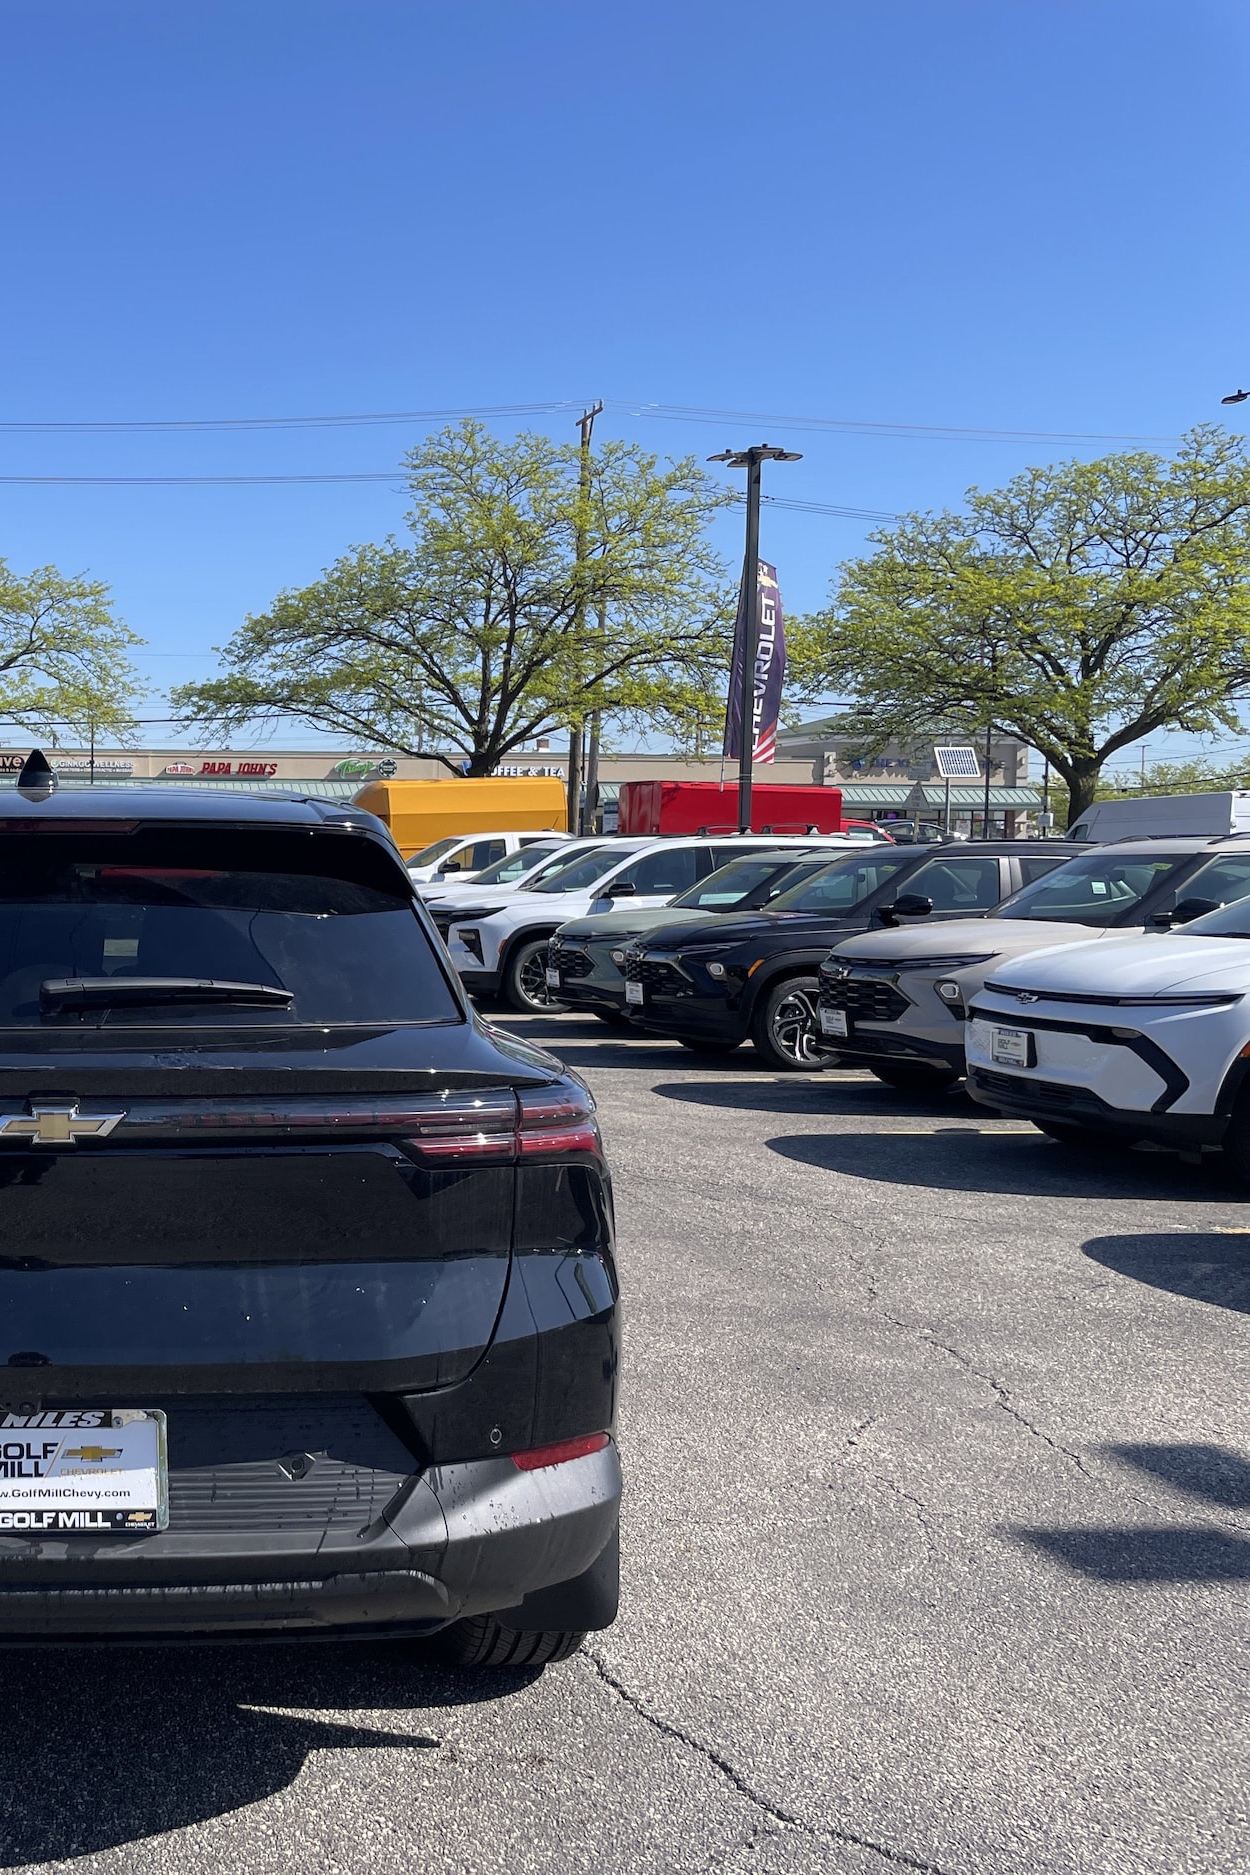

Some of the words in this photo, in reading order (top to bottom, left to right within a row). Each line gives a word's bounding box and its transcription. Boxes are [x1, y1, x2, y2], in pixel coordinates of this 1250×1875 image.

[201, 762, 231, 775] PAPA
[236, 763, 277, 775] JOHN'S
[491, 766, 523, 776] OFFEE
[528, 766, 538, 776] &
[544, 766, 565, 776] TEA
[1, 1411, 105, 1428] NILES
[58, 1511, 111, 1528] MILL
